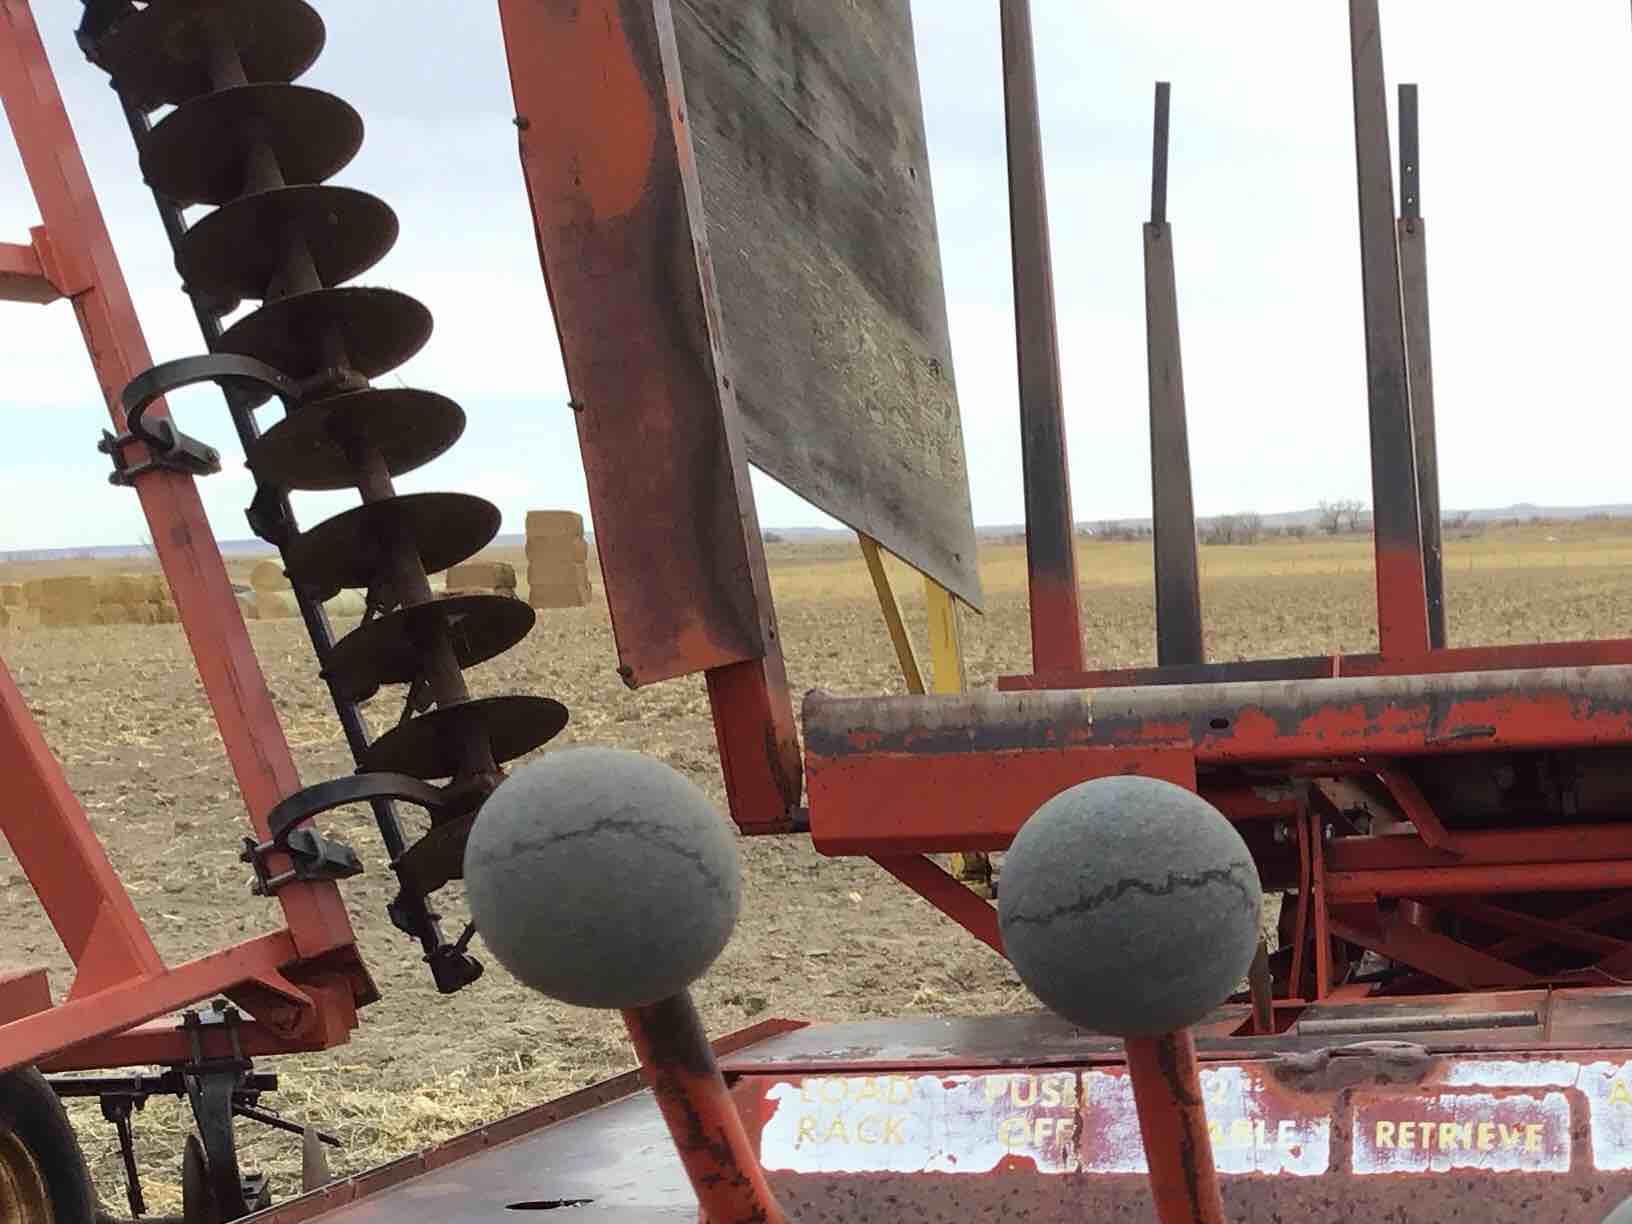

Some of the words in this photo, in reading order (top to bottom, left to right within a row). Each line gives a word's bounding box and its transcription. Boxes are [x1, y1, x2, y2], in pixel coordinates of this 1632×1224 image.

[797, 1113, 905, 1145] RACK
[998, 1117, 1074, 1149] OFF
[1207, 1119, 1297, 1149] ABLE
[1376, 1120, 1544, 1153] RETRIEVE
